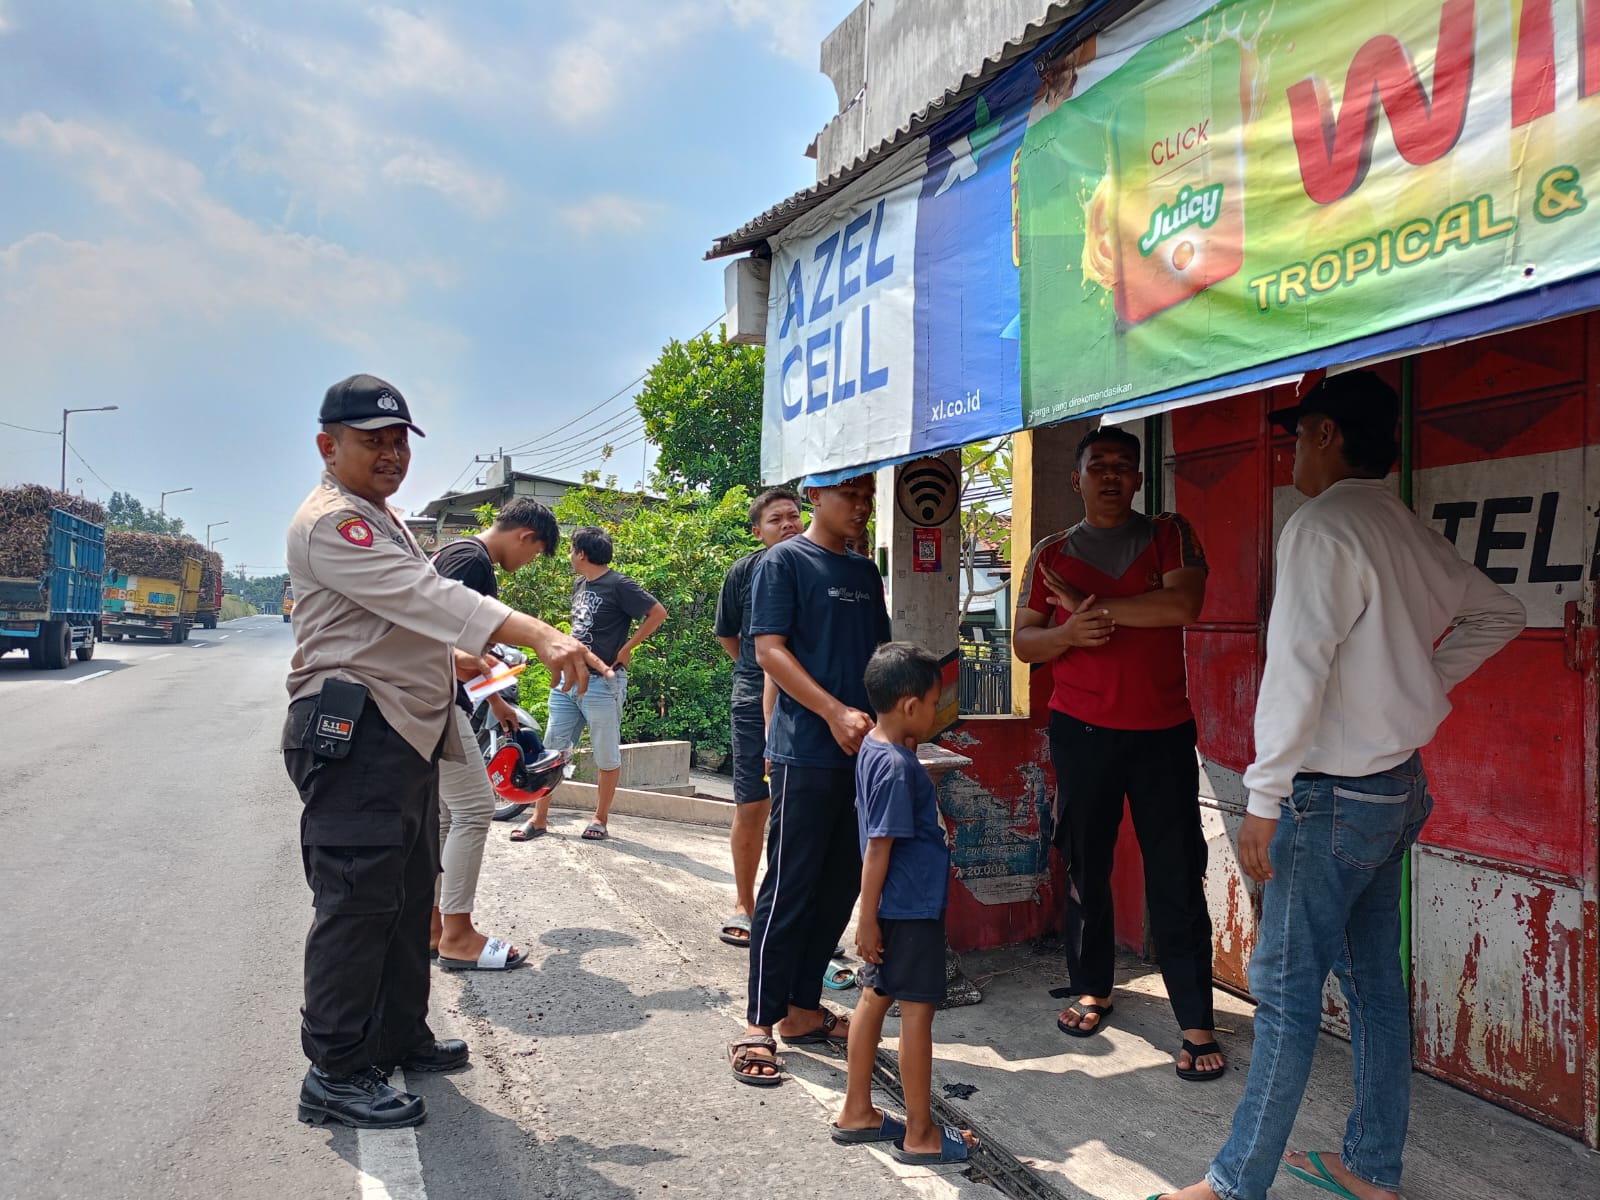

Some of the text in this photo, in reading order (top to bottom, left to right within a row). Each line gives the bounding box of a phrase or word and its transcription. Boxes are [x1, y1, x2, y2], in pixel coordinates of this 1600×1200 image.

[1150, 118, 1210, 167] CLICK
[1139, 183, 1223, 256] Juicy
[1250, 165, 1586, 312] TROPICAL &
[779, 198, 895, 339] AZEL
[780, 304, 889, 422] CELL
[931, 389, 981, 421] xl.co.id
[1052, 401, 1068, 414] yang
[1069, 382, 1133, 408] direkomendasikan
[1432, 491, 1600, 584] TEL
[103, 587, 144, 603] JABAL
[322, 720, 340, 730] 5.11
